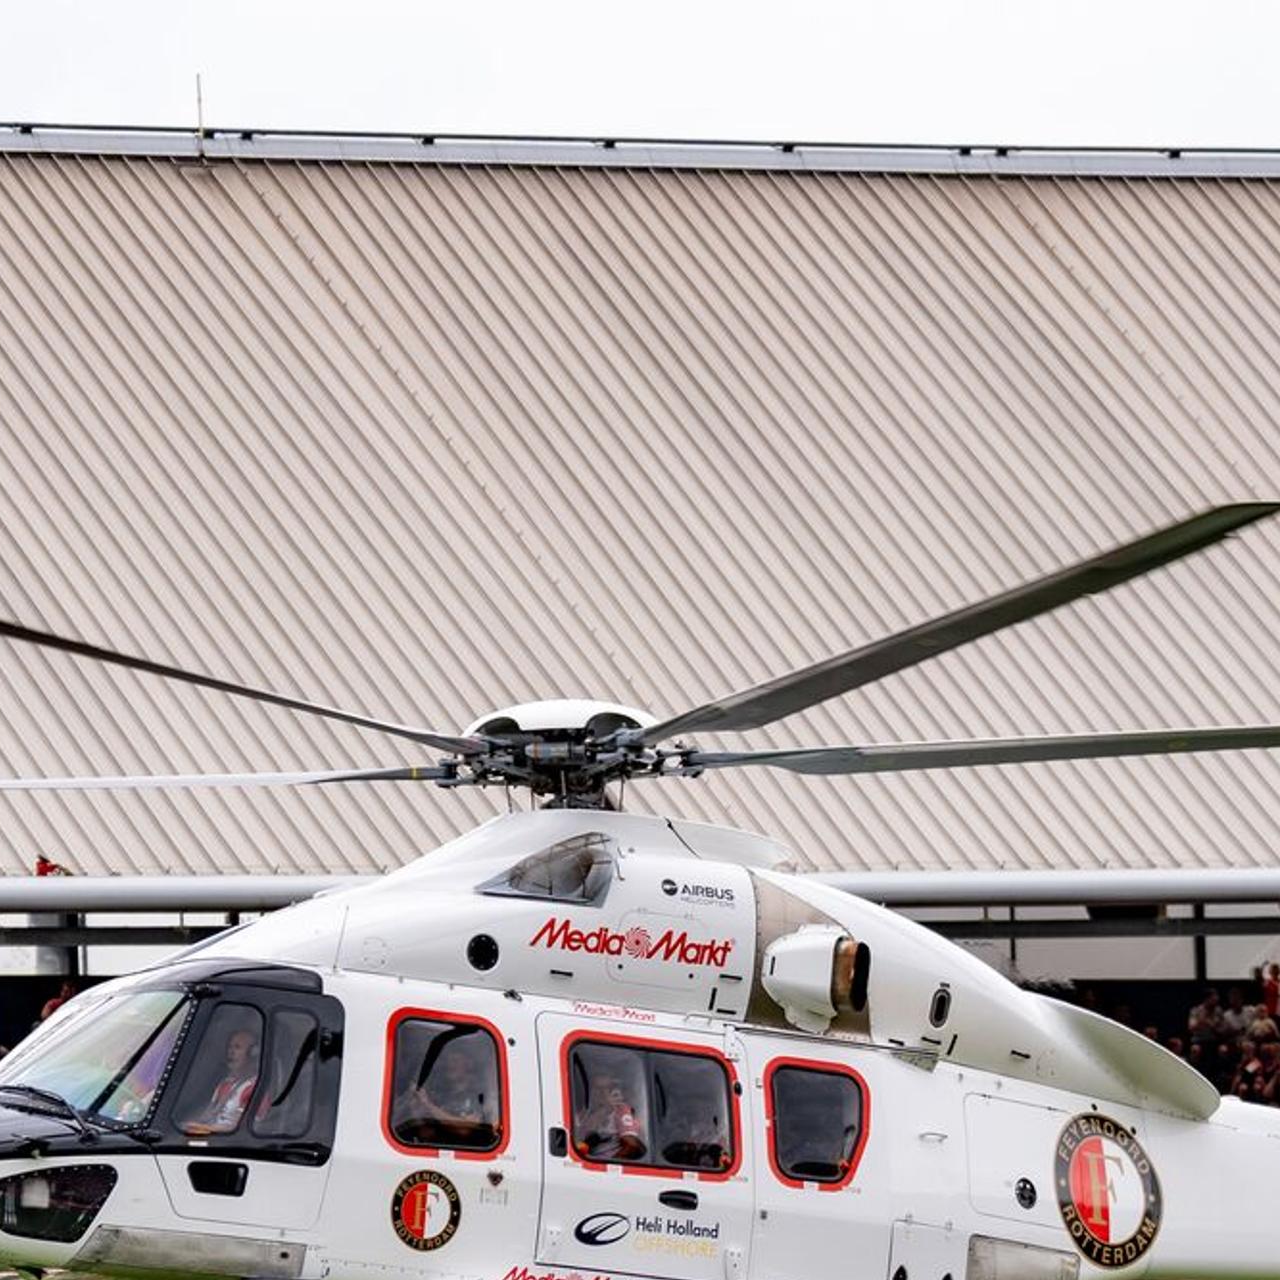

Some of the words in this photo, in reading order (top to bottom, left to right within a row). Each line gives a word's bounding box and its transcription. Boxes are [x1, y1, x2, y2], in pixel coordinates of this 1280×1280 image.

[681, 884, 735, 901] AIRBUS
[530, 918, 625, 955] Media
[646, 930, 732, 967] Markt
[635, 1216, 662, 1234] Heli
[666, 1218, 720, 1239] Holland
